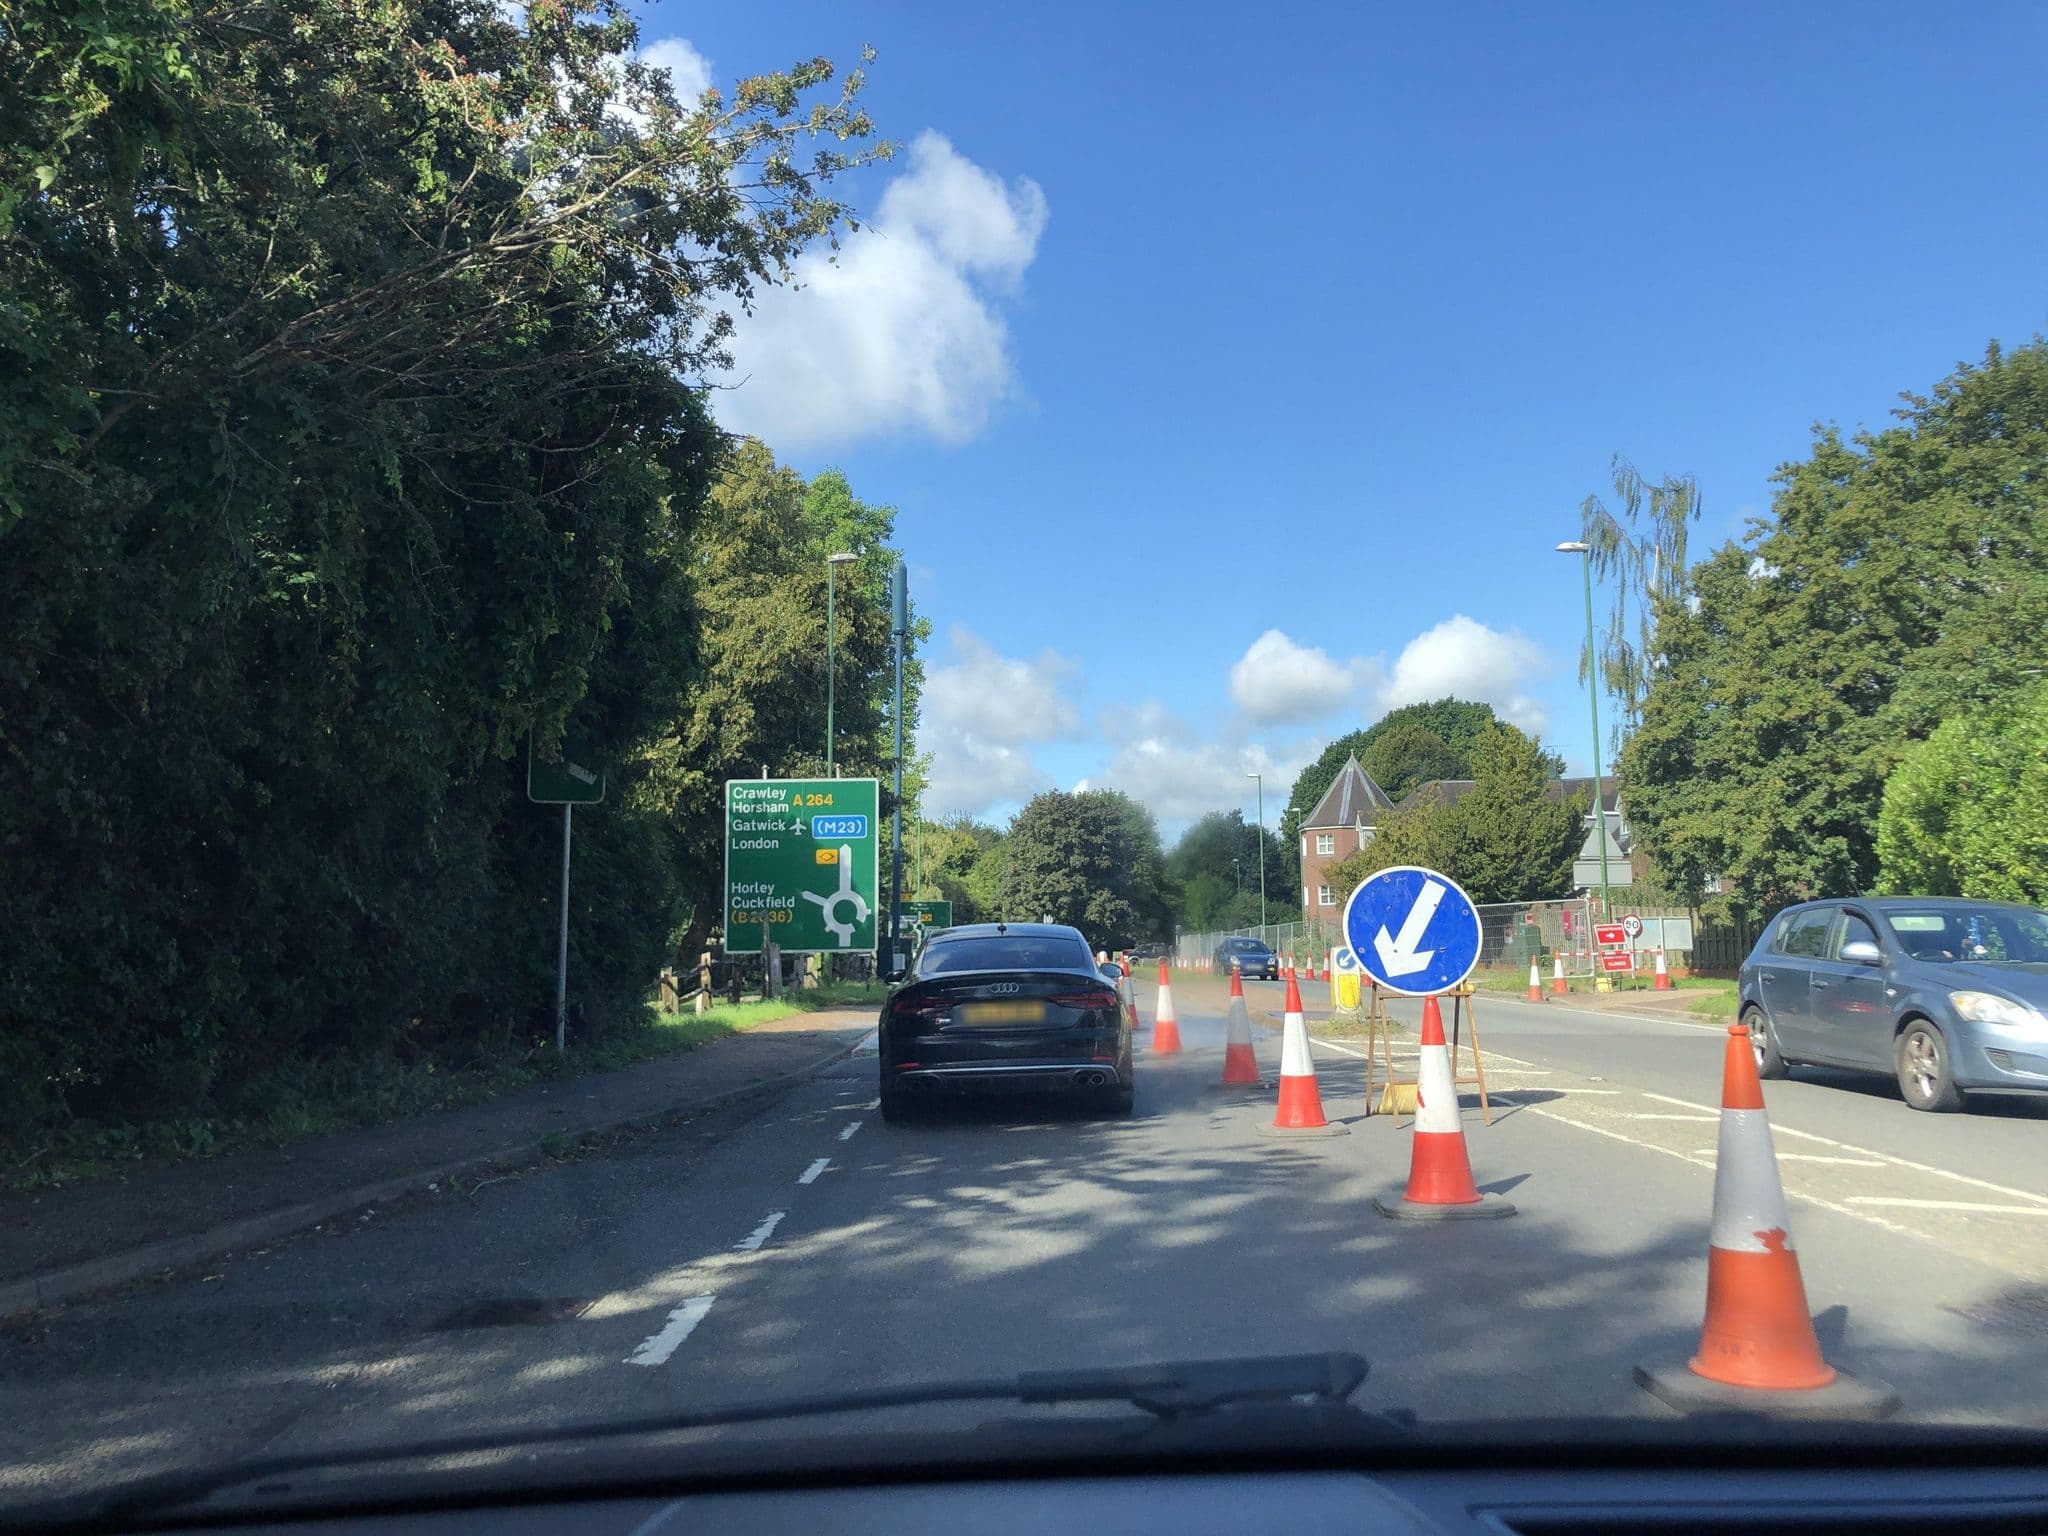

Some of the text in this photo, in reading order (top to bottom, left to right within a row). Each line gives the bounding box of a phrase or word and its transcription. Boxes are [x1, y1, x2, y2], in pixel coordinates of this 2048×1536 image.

[733, 786, 787, 801] Crawley
[806, 793, 834, 806] 264
[732, 801, 789, 813] Horsham
[732, 818, 786, 831] Gatwick
[817, 819, 862, 835] (M23)
[732, 837, 779, 849] London
[731, 881, 775, 896] Horley
[731, 895, 796, 909] Cuckfield
[1625, 921, 1638, 929] 50
